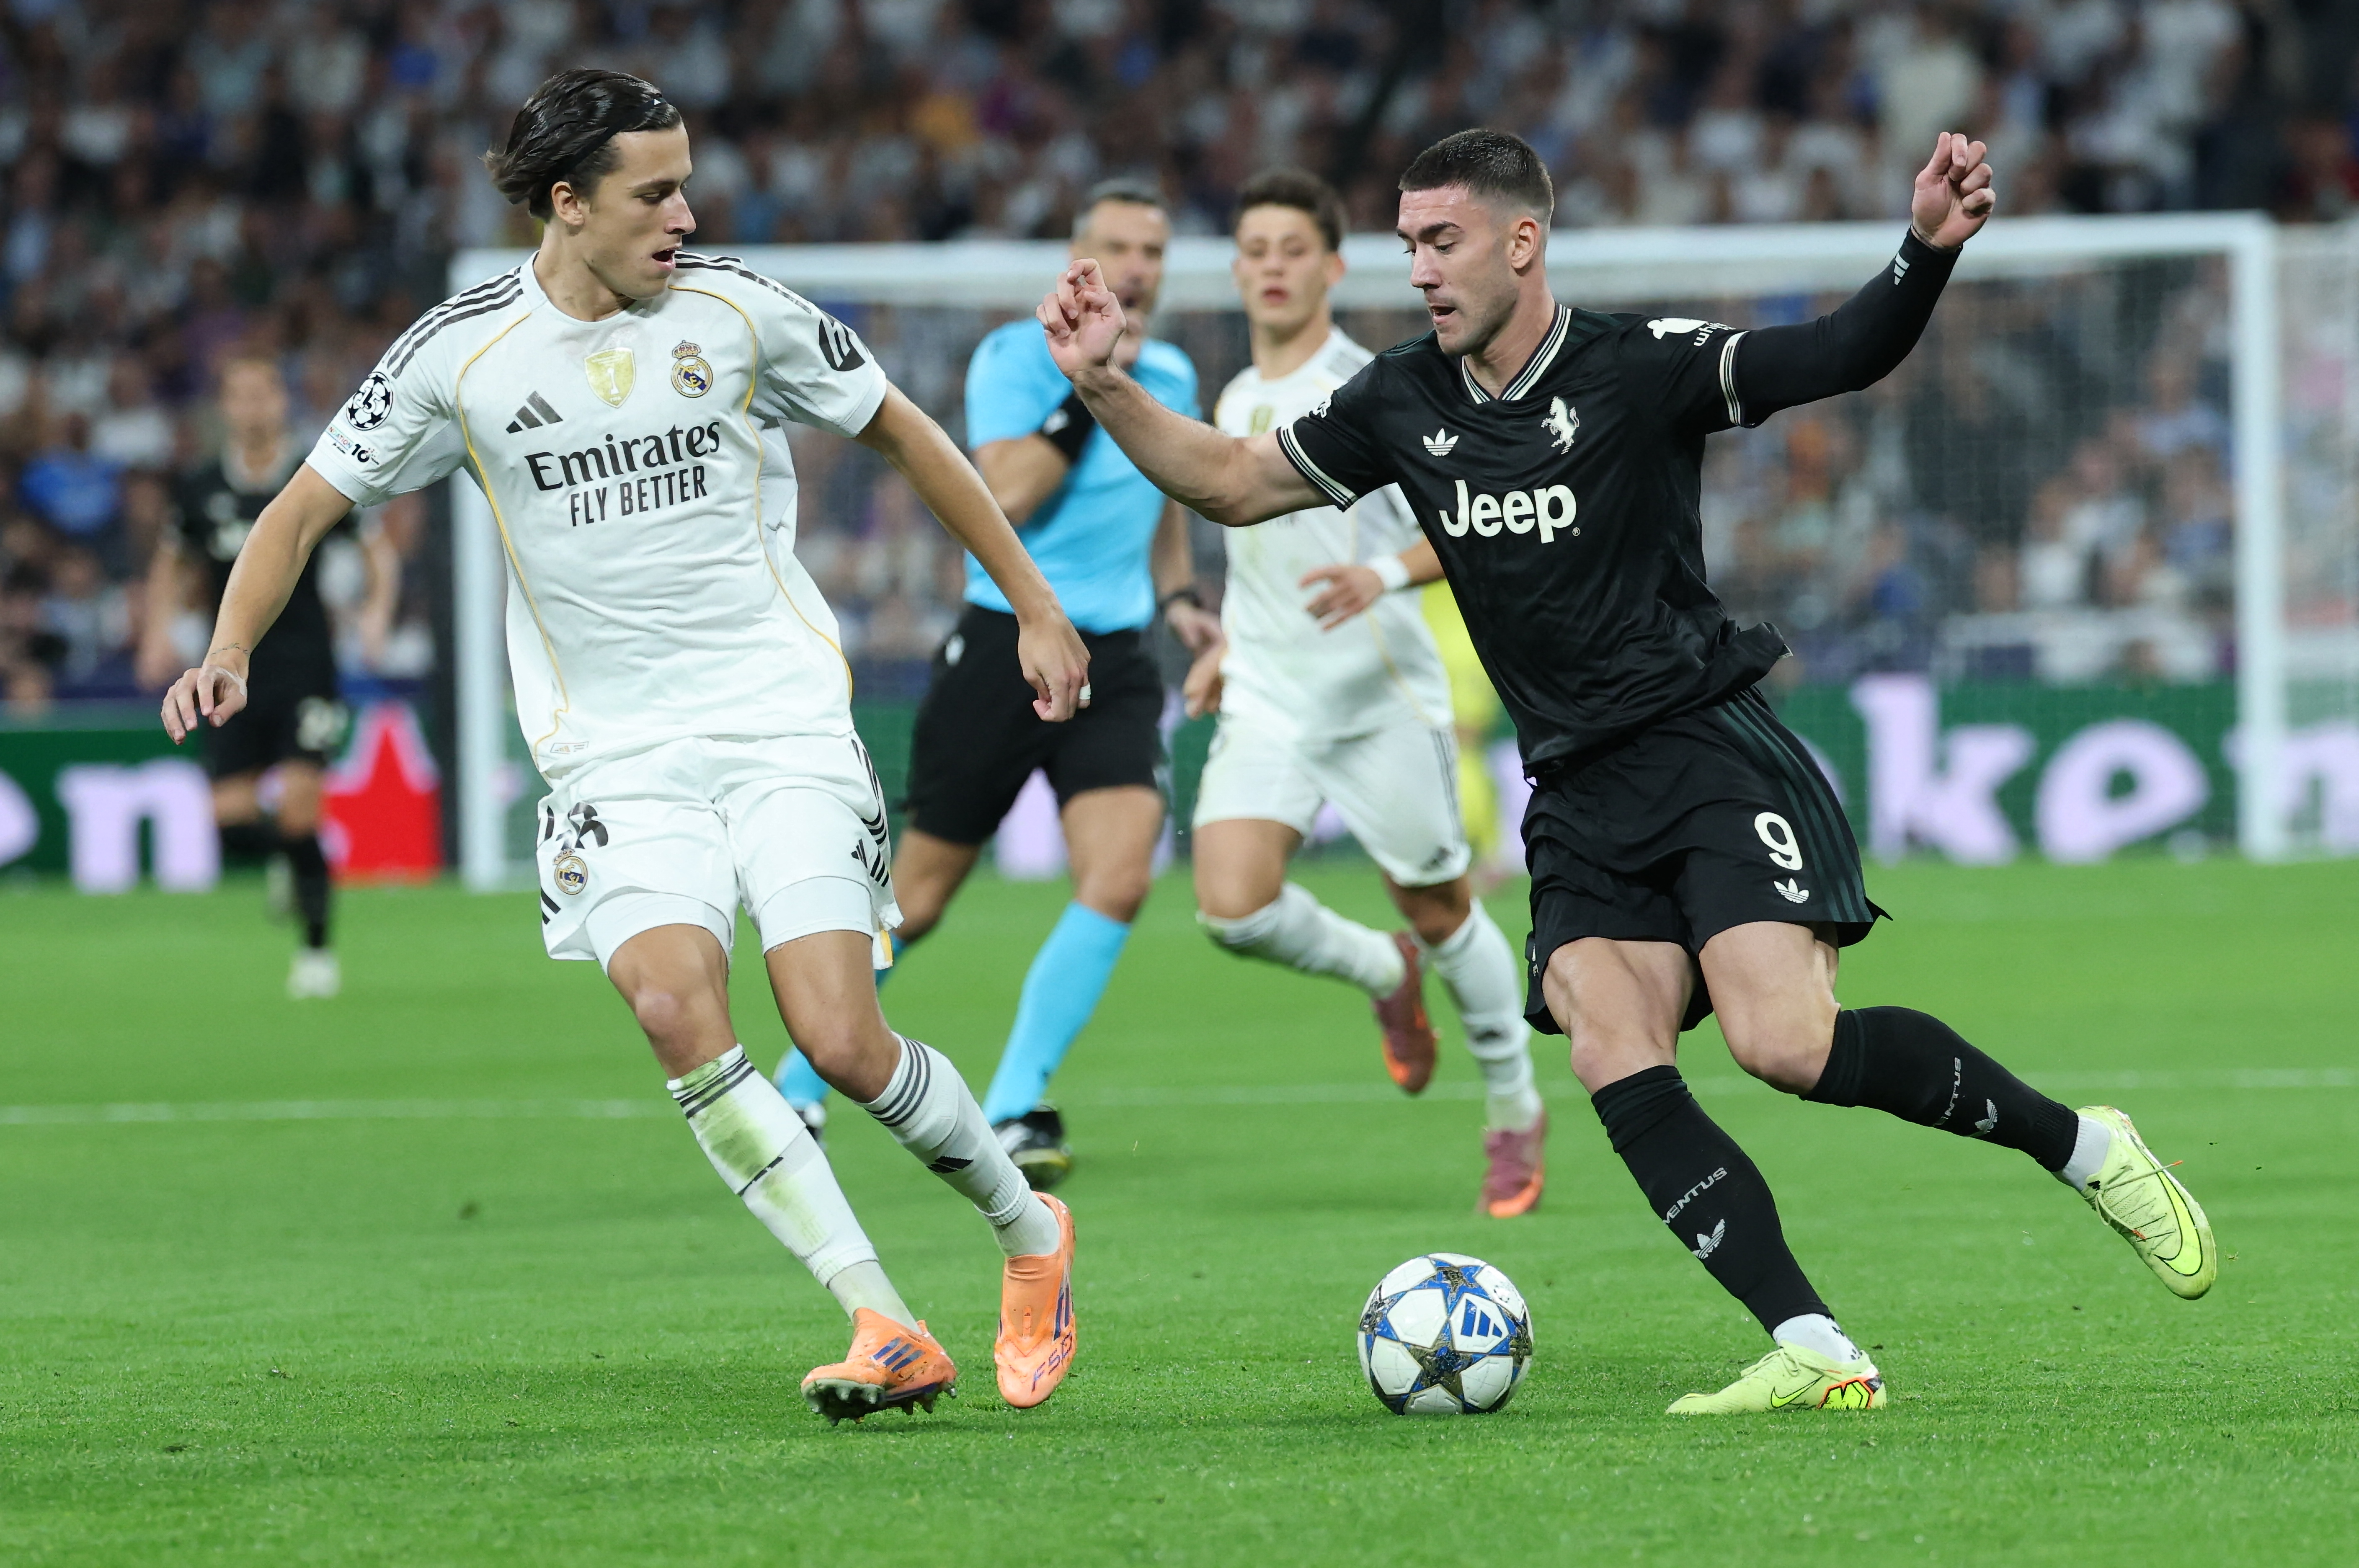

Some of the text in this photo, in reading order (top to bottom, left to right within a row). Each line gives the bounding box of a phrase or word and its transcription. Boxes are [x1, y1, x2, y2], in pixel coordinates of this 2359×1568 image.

[351, 443, 370, 463] 10
[524, 421, 720, 491] Emirates
[571, 465, 707, 527] FLY BETTER
[1438, 479, 1577, 544] Jeep
[1754, 812, 1803, 871] 9
